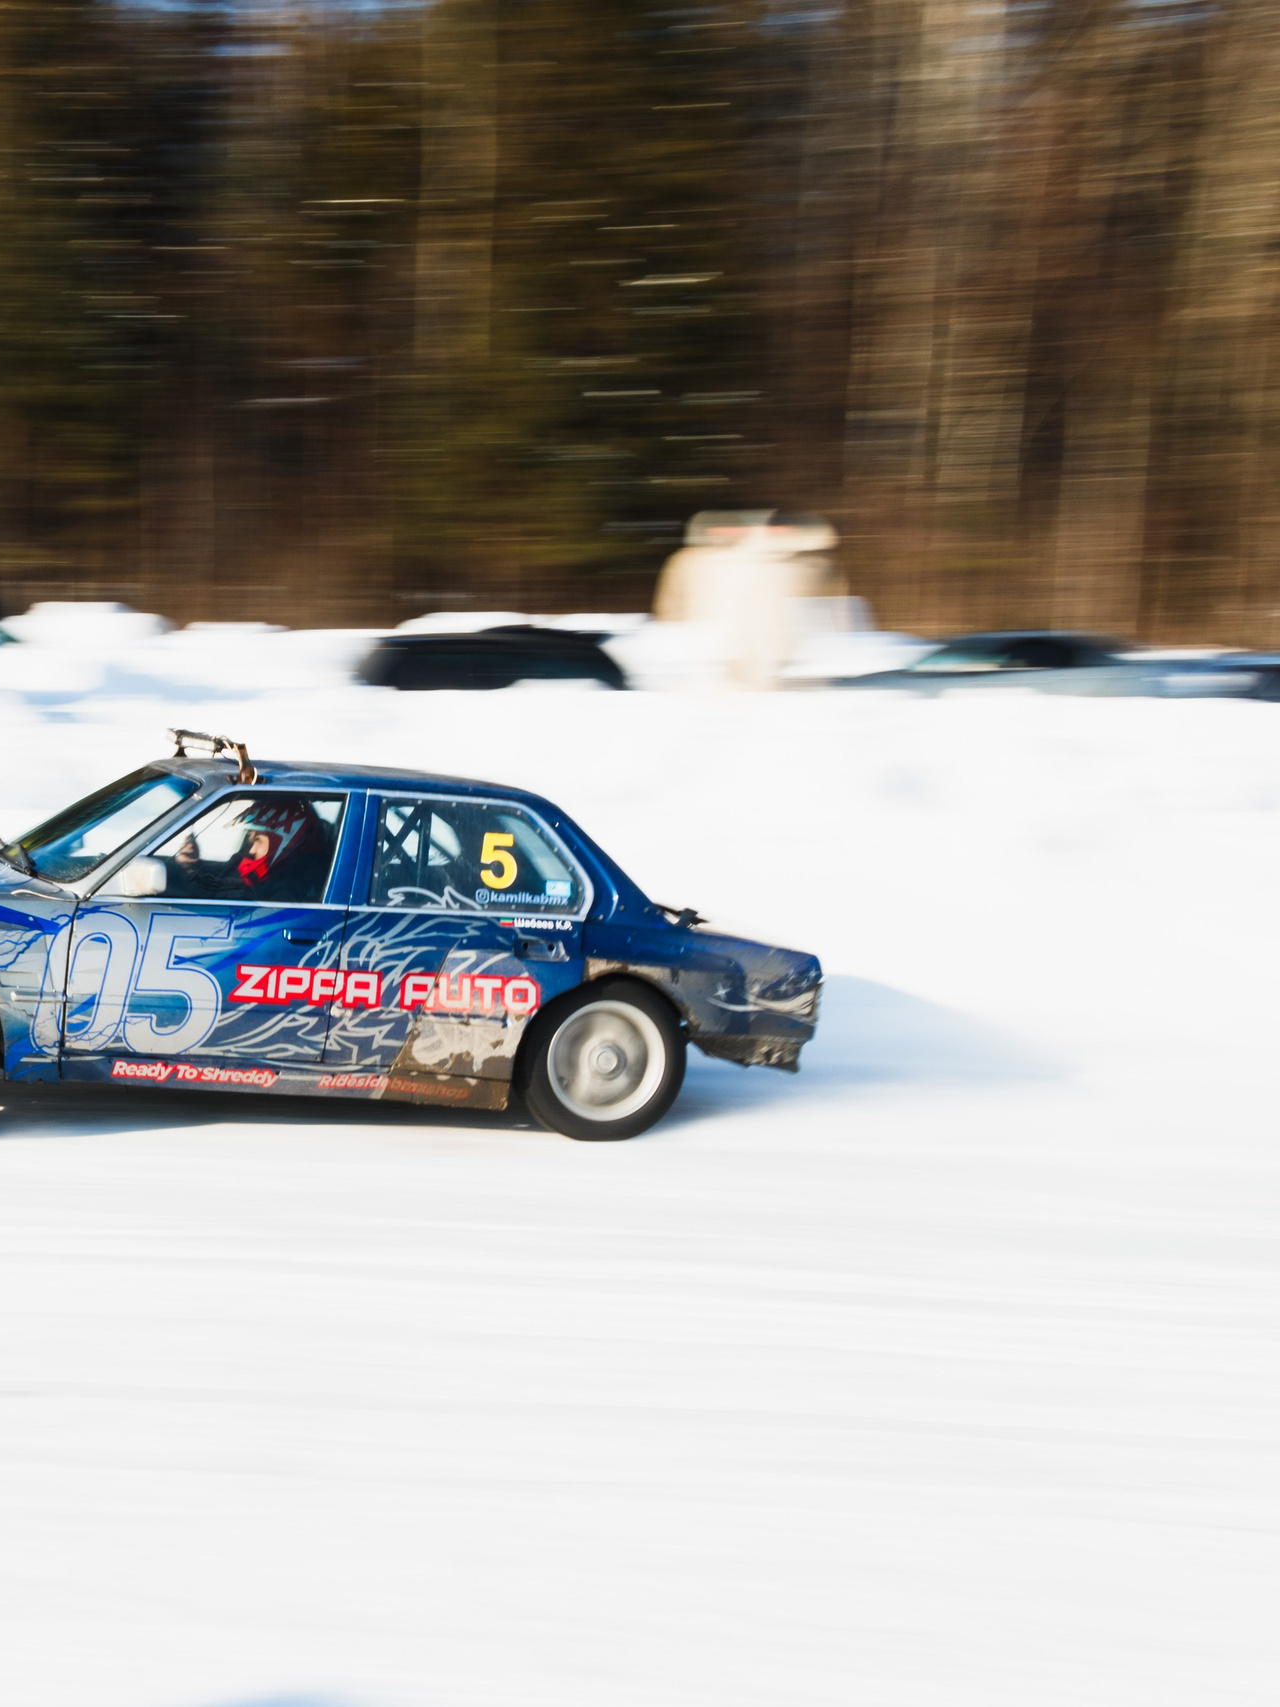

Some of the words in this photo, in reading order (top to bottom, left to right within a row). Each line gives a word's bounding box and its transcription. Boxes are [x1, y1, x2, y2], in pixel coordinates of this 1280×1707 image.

[480, 832, 517, 889] 5
[30, 909, 235, 1055] 05
[233, 965, 379, 1004] ZIPPA
[403, 972, 538, 1010] AUTO
[112, 1061, 171, 1081] Ready
[176, 1065, 198, 1080] To
[201, 1067, 280, 1088] Shreddy
